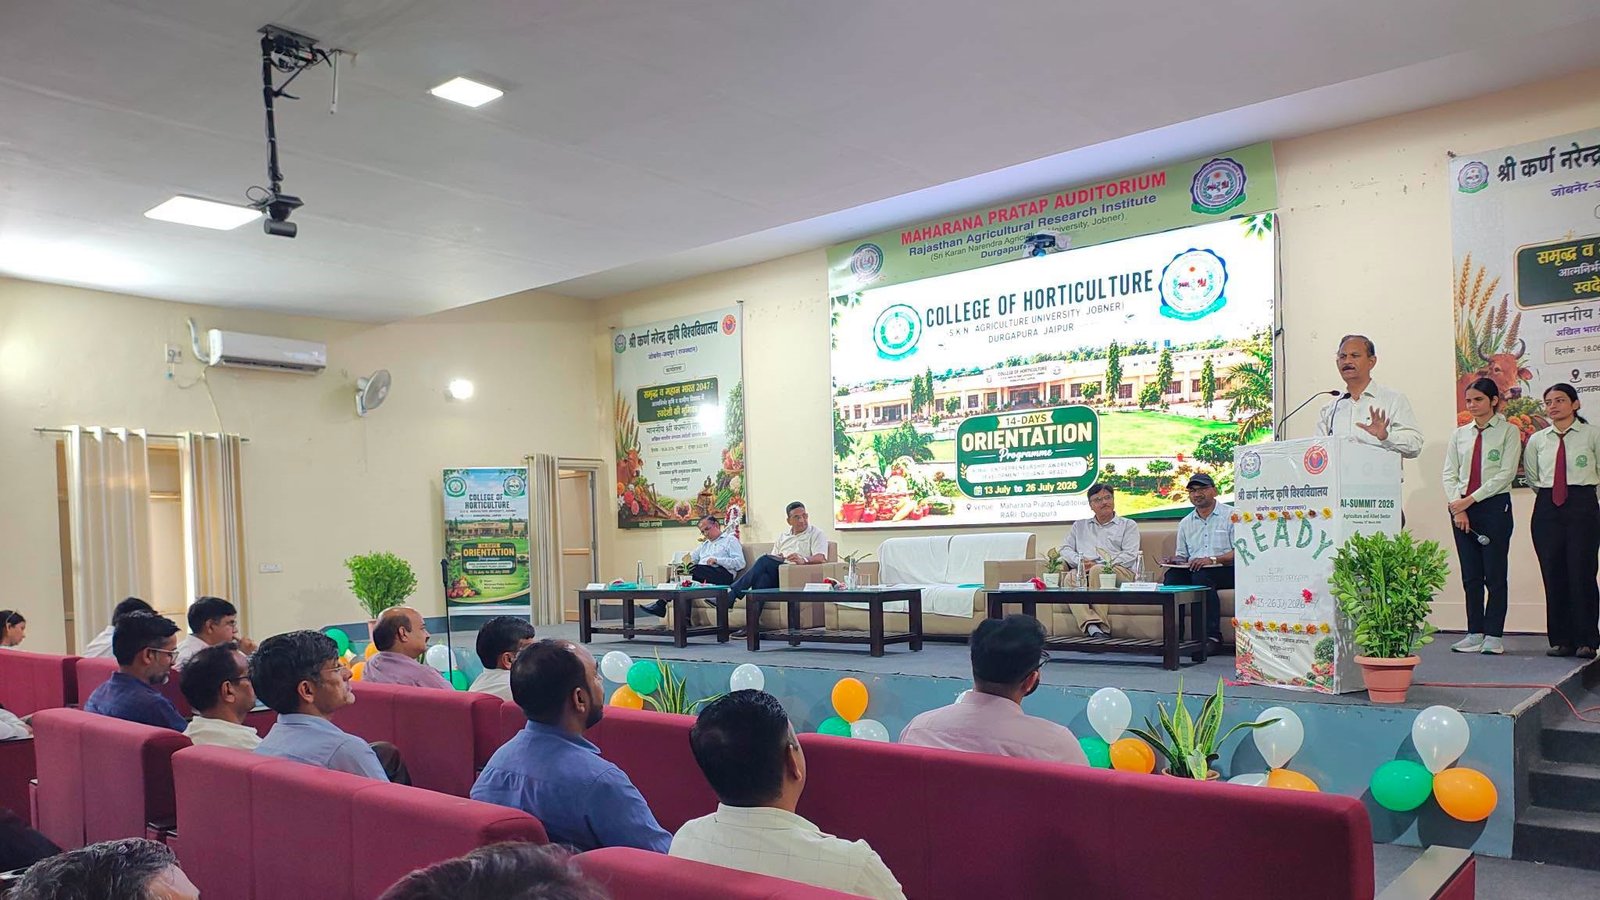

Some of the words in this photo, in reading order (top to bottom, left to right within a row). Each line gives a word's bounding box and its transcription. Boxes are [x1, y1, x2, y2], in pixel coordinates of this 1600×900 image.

[1497, 156, 1516, 182] श्री
[1520, 146, 1556, 177] कर्ण
[901, 214, 984, 246] MAHARANA
[988, 198, 1049, 225] PRATAP
[1054, 171, 1167, 210] AUDITORIUM
[909, 238, 963, 257] Rajasthan
[966, 220, 1034, 245] Agricultural
[1038, 206, 1097, 227] Research
[1101, 194, 1157, 214] Institute
[944, 246, 967, 258] Karan
[968, 239, 1003, 253] Narendra
[1092, 212, 1124, 226] Jobner)
[1581, 243, 1595, 257] व
[926, 298, 990, 327] COLLEGE
[998, 293, 1016, 316] OF
[1023, 269, 1153, 312] HORTICULTURE
[975, 316, 1029, 332] AGRICULTURE
[1031, 308, 1081, 324] UNIVERSITY
[1541, 306, 1593, 325] माननीय
[637, 329, 650, 347] कर्ण
[650, 328, 666, 345] नरेन्द्र
[667, 324, 680, 345] कृषि
[680, 319, 719, 340] विश्वविद्यालय
[988, 328, 1038, 343] DURGAPURA
[1043, 322, 1074, 335] JAIPUR
[1556, 326, 1581, 337] अखिल
[1555, 346, 1576, 357] दिनांक
[1006, 413, 1047, 426] 14-DAYS
[961, 421, 1093, 452] ORIENTATION
[998, 447, 1053, 463] Programme
[469, 493, 494, 501] COLLEGE
[984, 486, 993, 494] 13
[994, 485, 1011, 495] July
[1013, 485, 1023, 493] to
[1025, 483, 1036, 492] 26
[1037, 482, 1055, 493] July
[1056, 481, 1078, 491] 2026
[1246, 487, 1259, 500] कर्ण
[1259, 486, 1275, 500] नरेन्द्र
[1276, 485, 1289, 502] कृषि
[1290, 483, 1328, 498] विश्वविद्यालय
[464, 501, 510, 509] HORTICULTURE
[1340, 498, 1377, 508] AI-SUMMIT
[1377, 499, 1395, 509] 2026
[1233, 517, 1334, 566] READY
[463, 548, 515, 557] ORIENTATION
